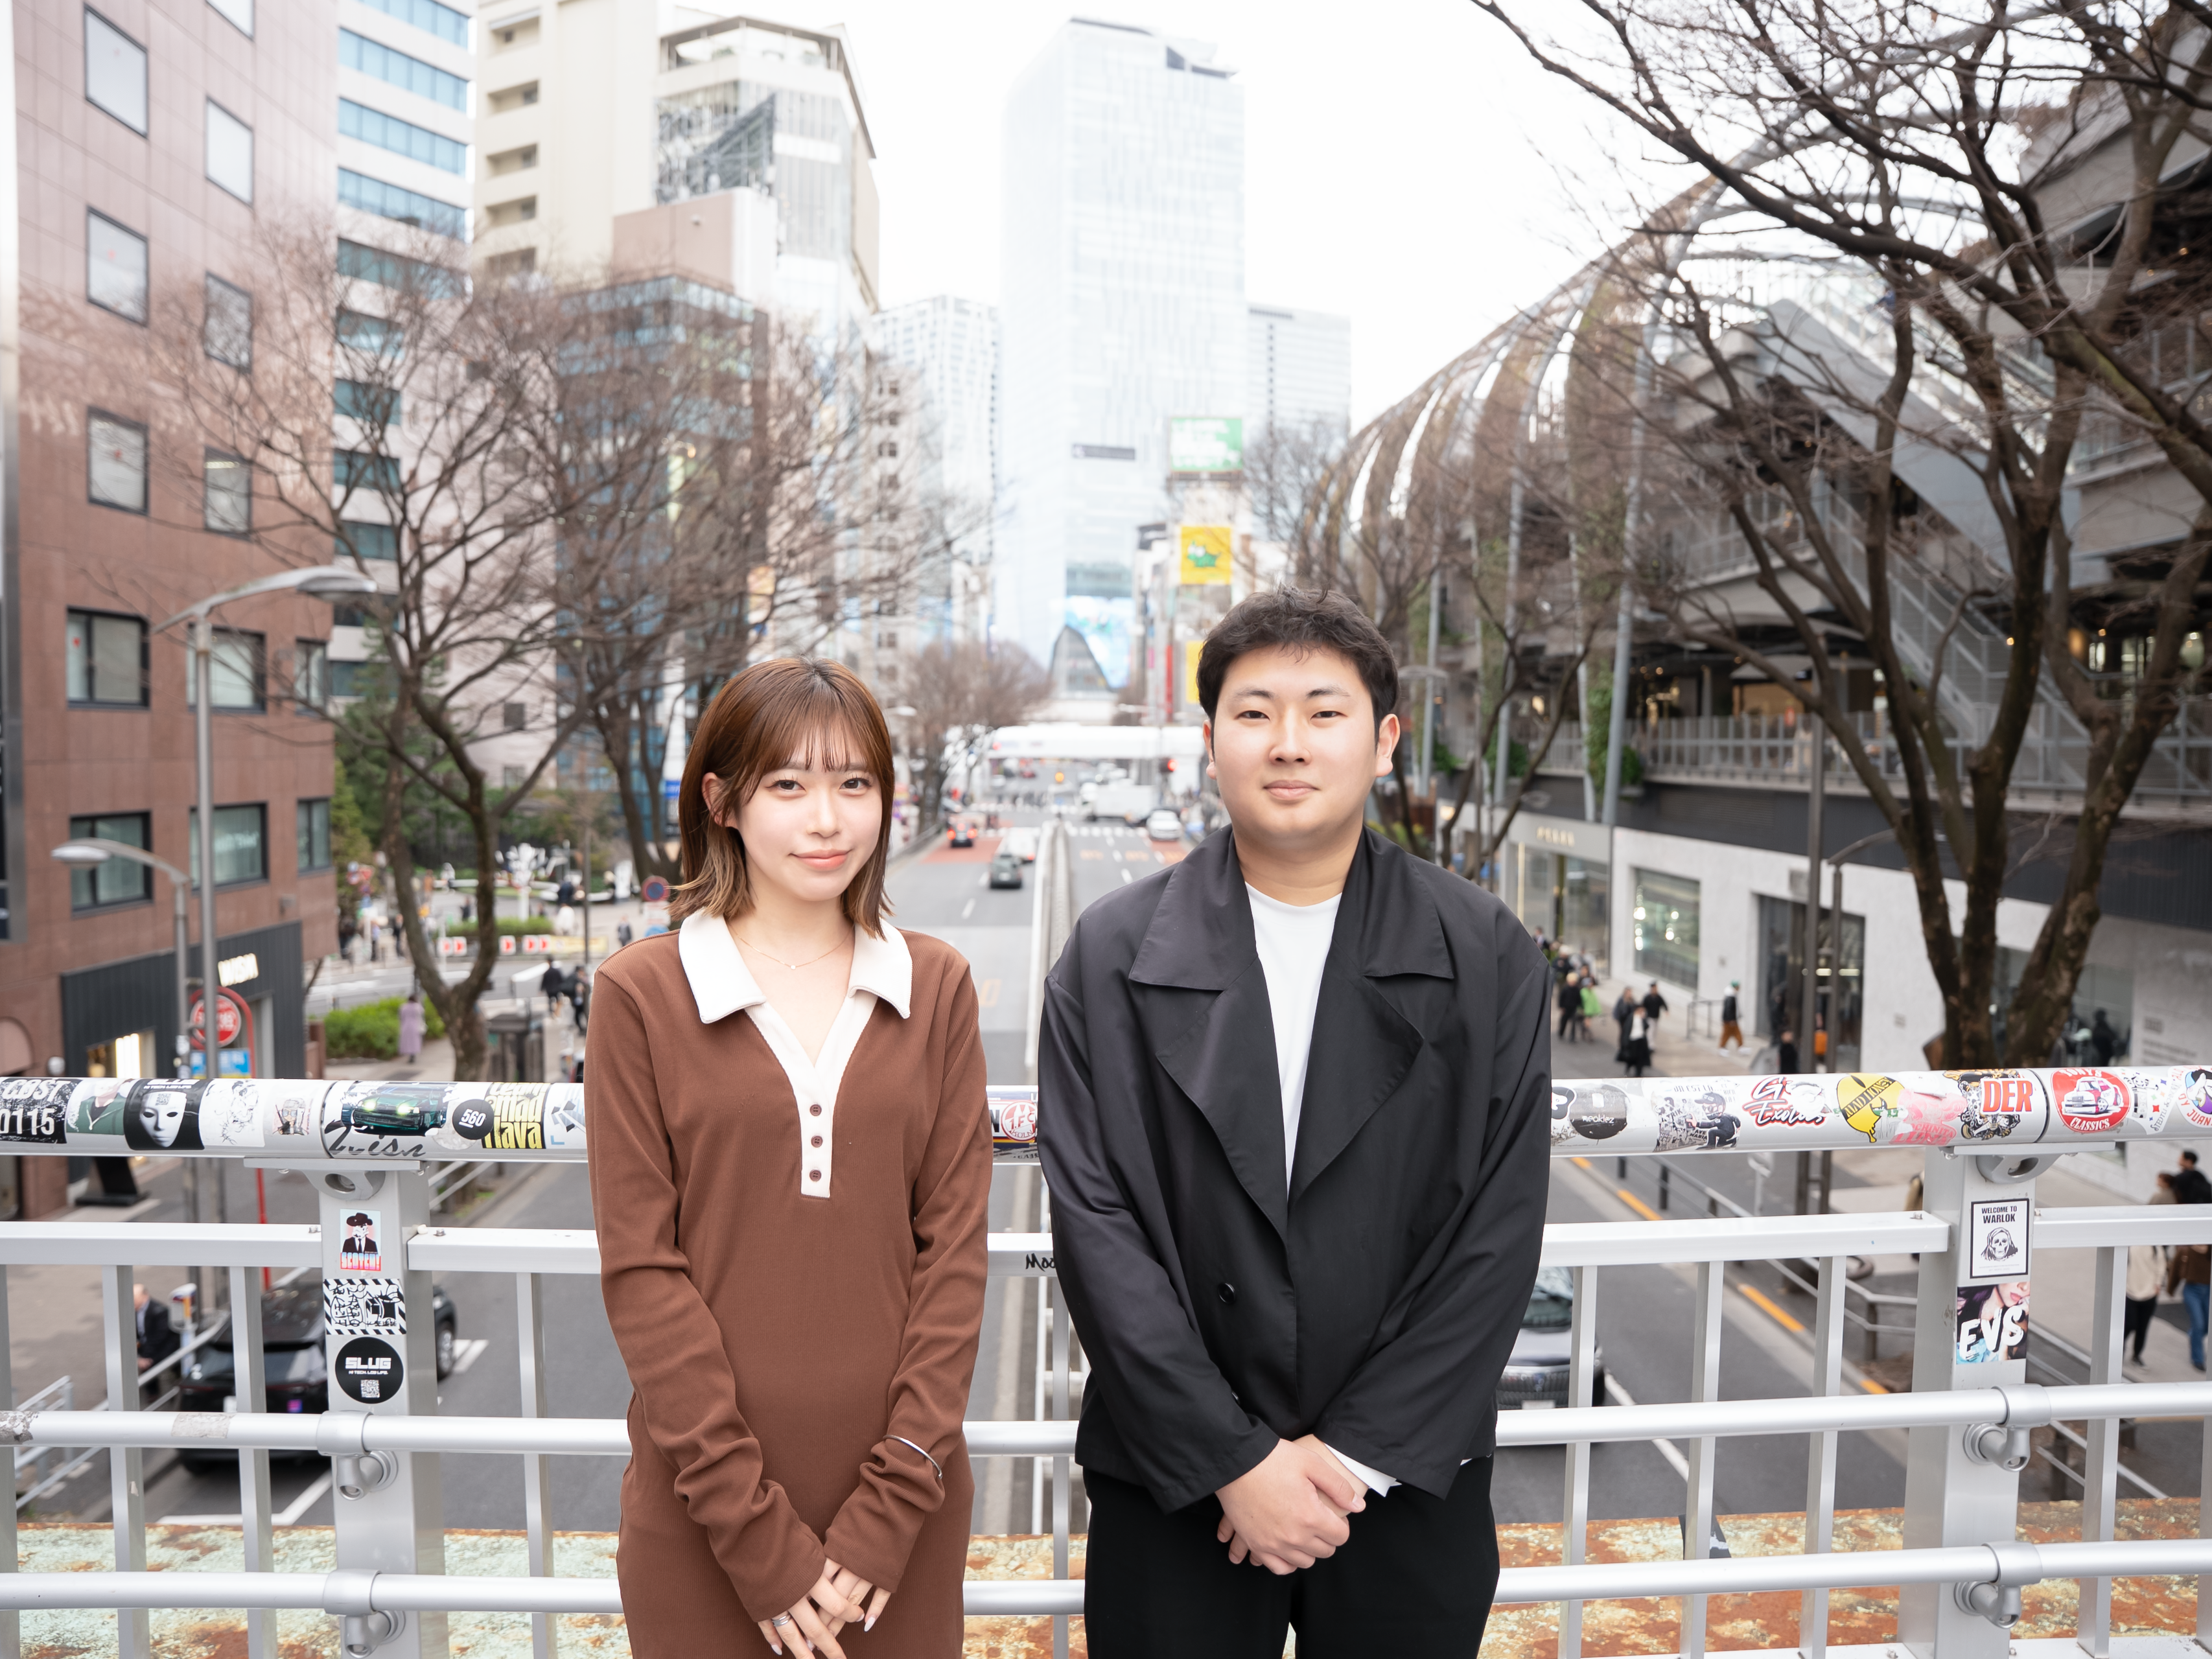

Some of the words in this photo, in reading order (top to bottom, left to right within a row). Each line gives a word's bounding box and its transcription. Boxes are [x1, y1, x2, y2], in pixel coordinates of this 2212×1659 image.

[1983, 1080, 2033, 1112] DER
[461, 1108, 486, 1127] 560
[2070, 1117, 2110, 1131] CLASSICS
[2186, 1108, 2212, 1126] JUAN
[1983, 1213, 2016, 1224] WARLOK
[345, 1356, 391, 1369] SLUG
